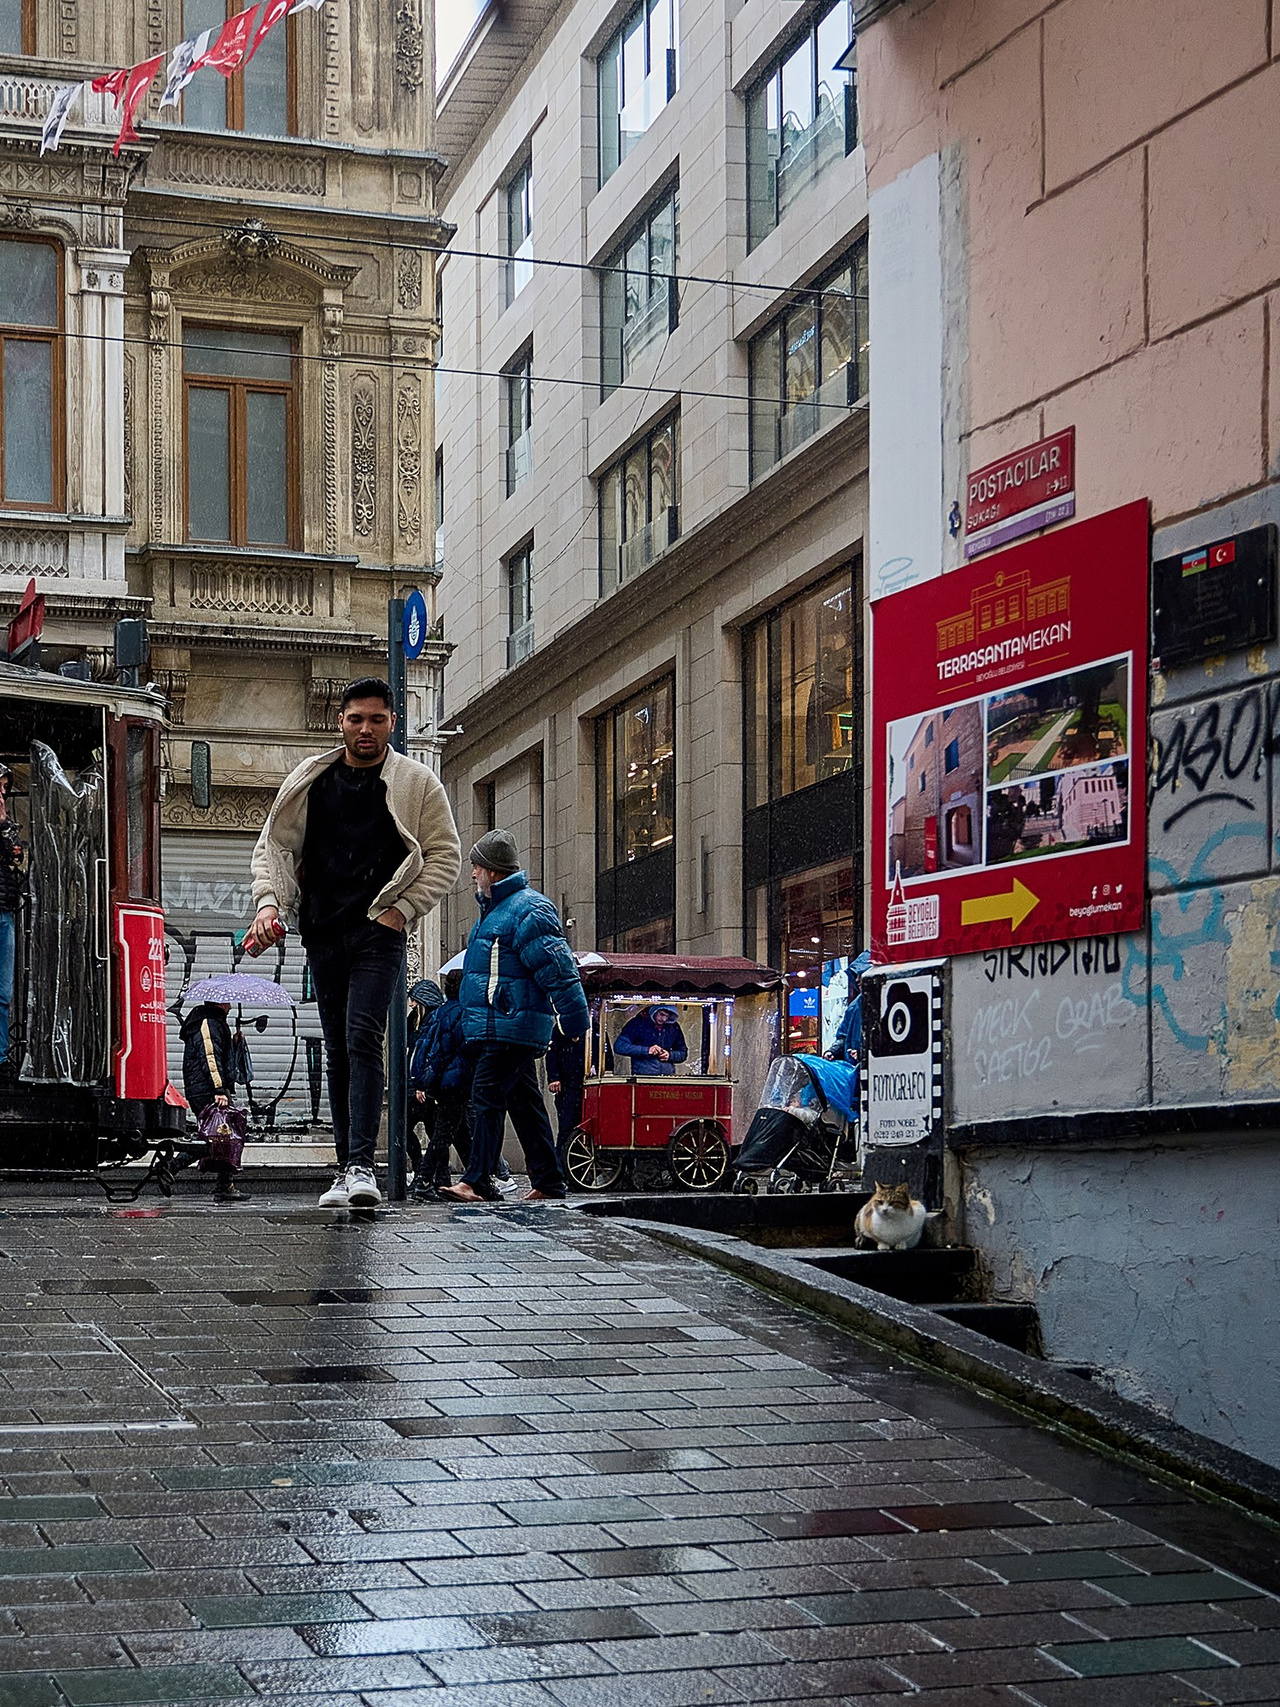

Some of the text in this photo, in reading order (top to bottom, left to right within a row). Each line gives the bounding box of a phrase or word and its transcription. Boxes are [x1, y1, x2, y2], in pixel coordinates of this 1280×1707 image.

[969, 446, 1060, 506] POSTACILAR
[936, 620, 1072, 681] TERRASANTAMEKAN
[908, 898, 938, 924] BEYOĞLU
[872, 1070, 926, 1102] FOTOĞRAFÇI
[879, 1119, 896, 1128] FOTO
